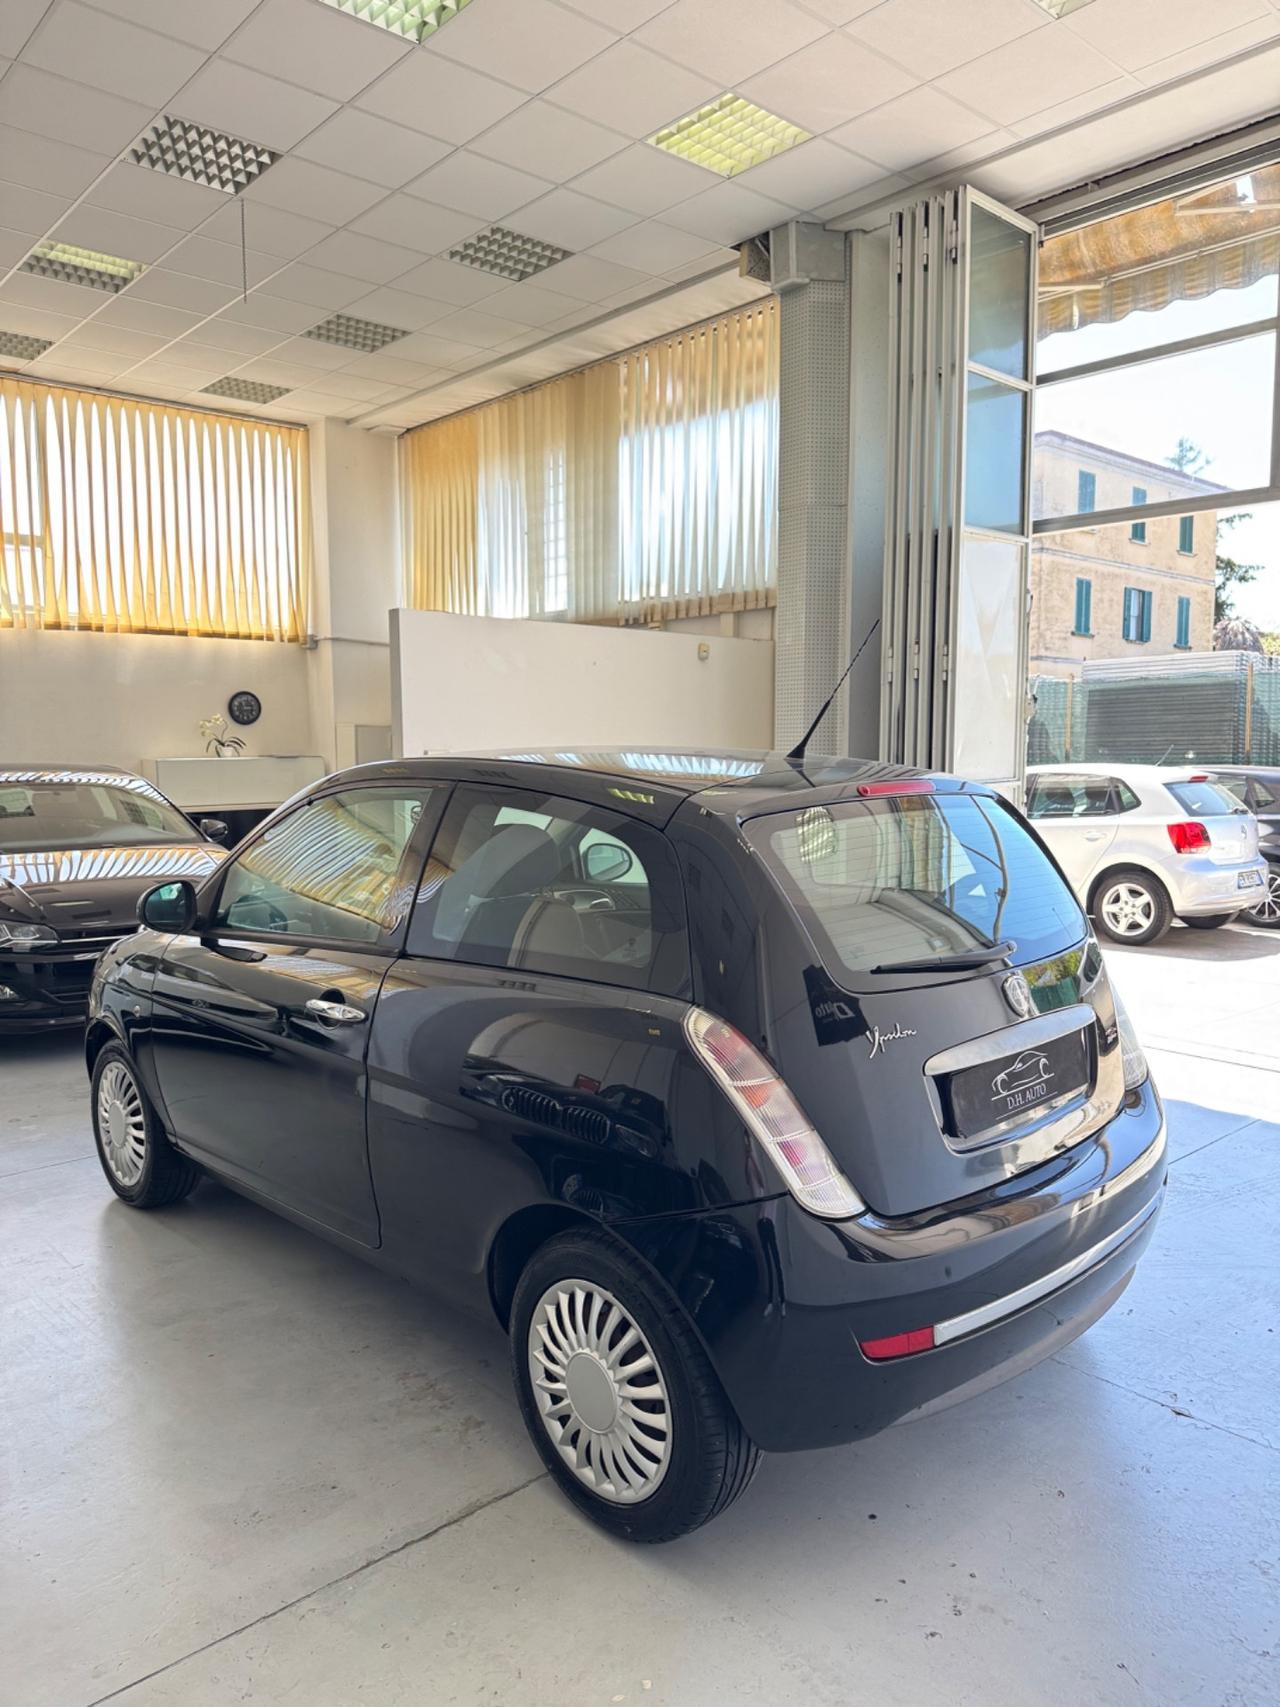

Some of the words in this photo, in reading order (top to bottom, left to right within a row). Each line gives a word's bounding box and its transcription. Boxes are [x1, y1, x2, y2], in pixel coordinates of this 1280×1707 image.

[865, 1022, 917, 1059] Ypsilon
[1006, 1092, 1025, 1110] D.H.
[1025, 1083, 1047, 1103] AUTO
